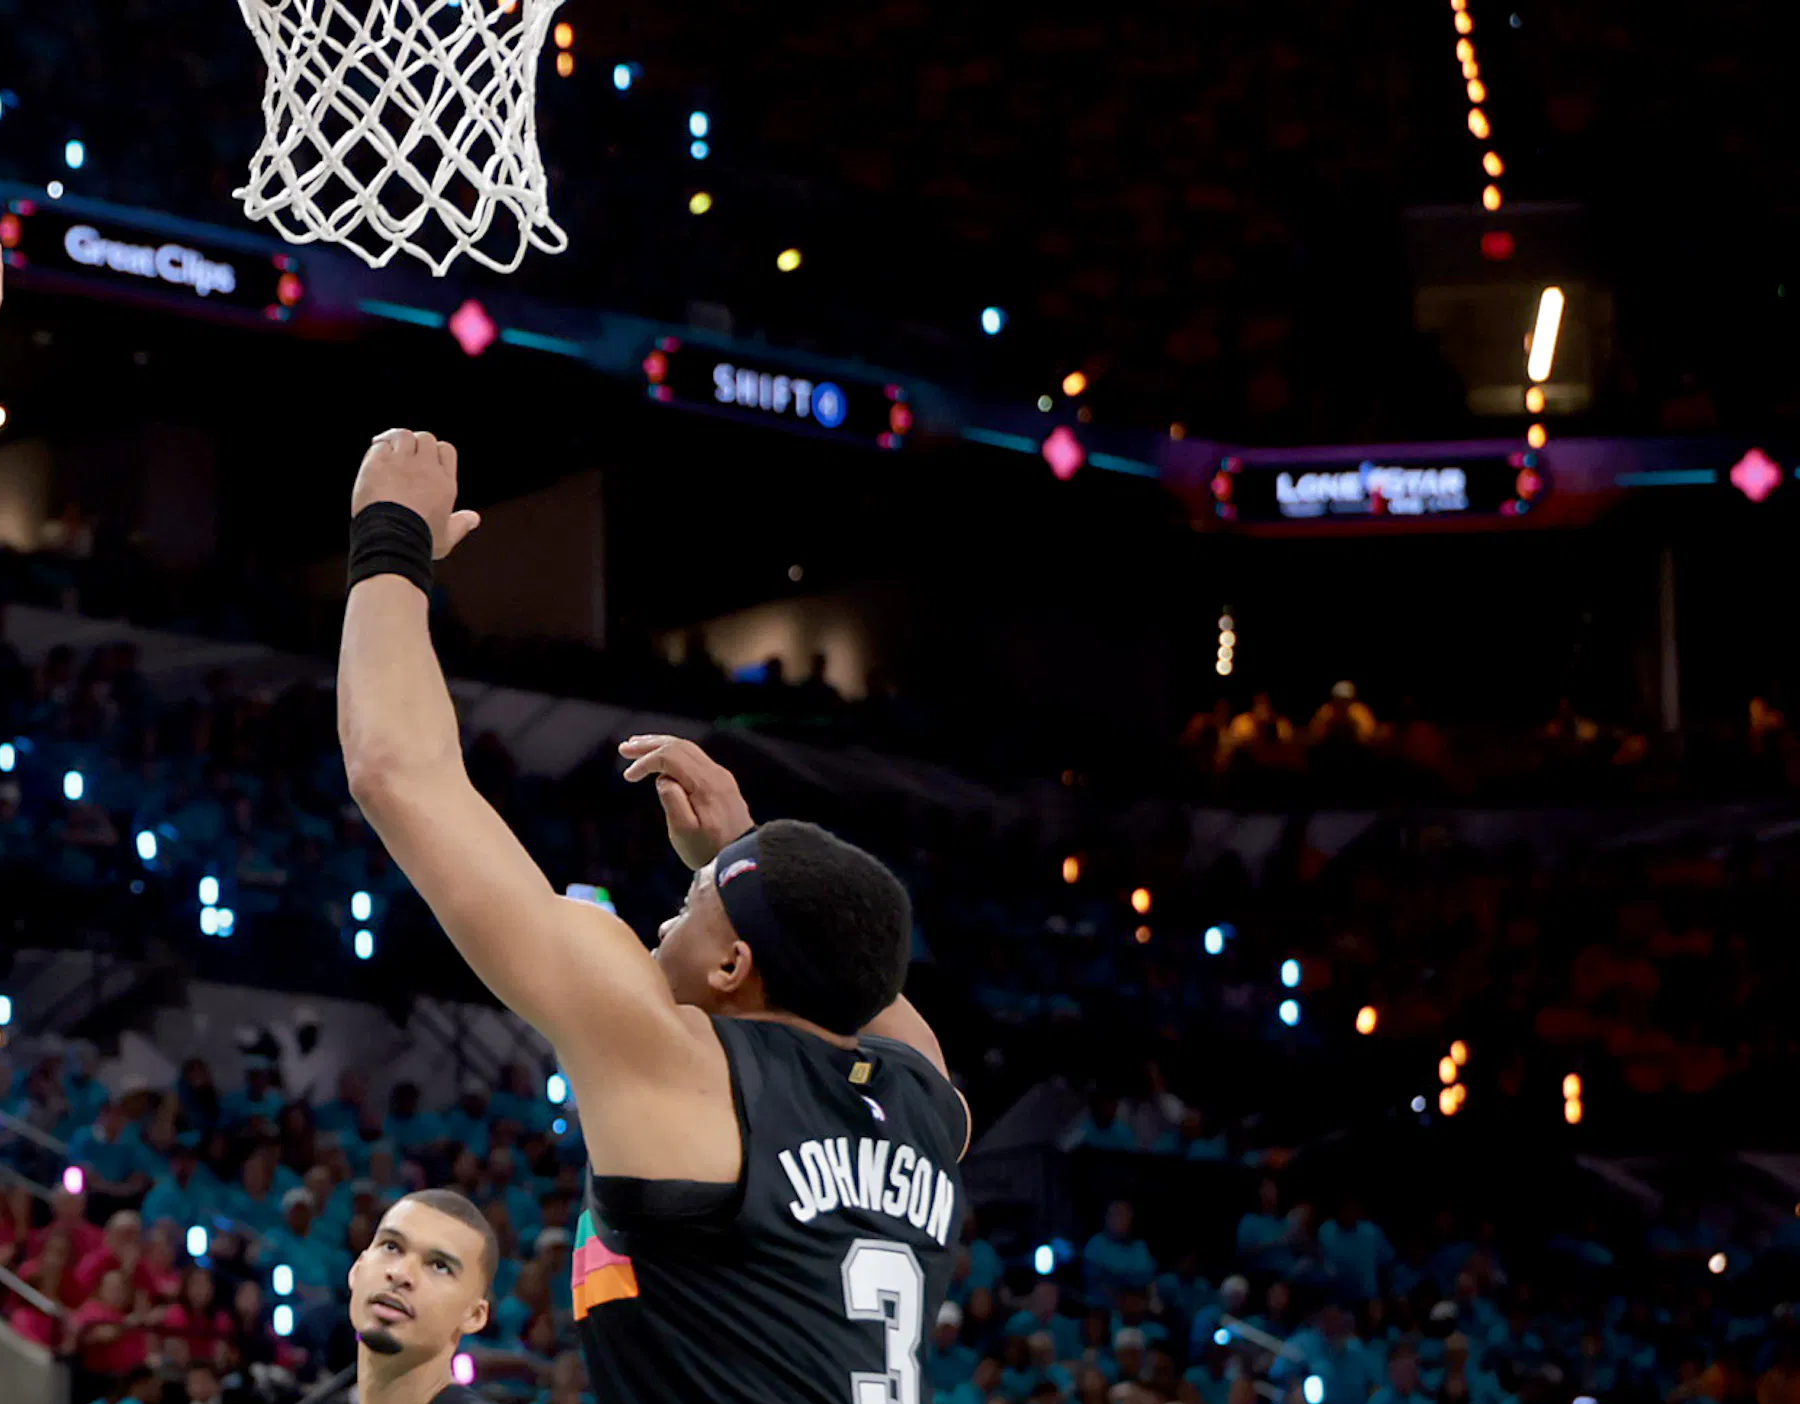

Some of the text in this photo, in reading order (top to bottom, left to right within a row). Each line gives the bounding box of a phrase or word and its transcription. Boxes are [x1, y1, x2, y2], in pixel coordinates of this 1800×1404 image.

[155, 243, 236, 297] Clips
[1276, 471, 1363, 504] LONE
[778, 1136, 955, 1247] JOHNSON
